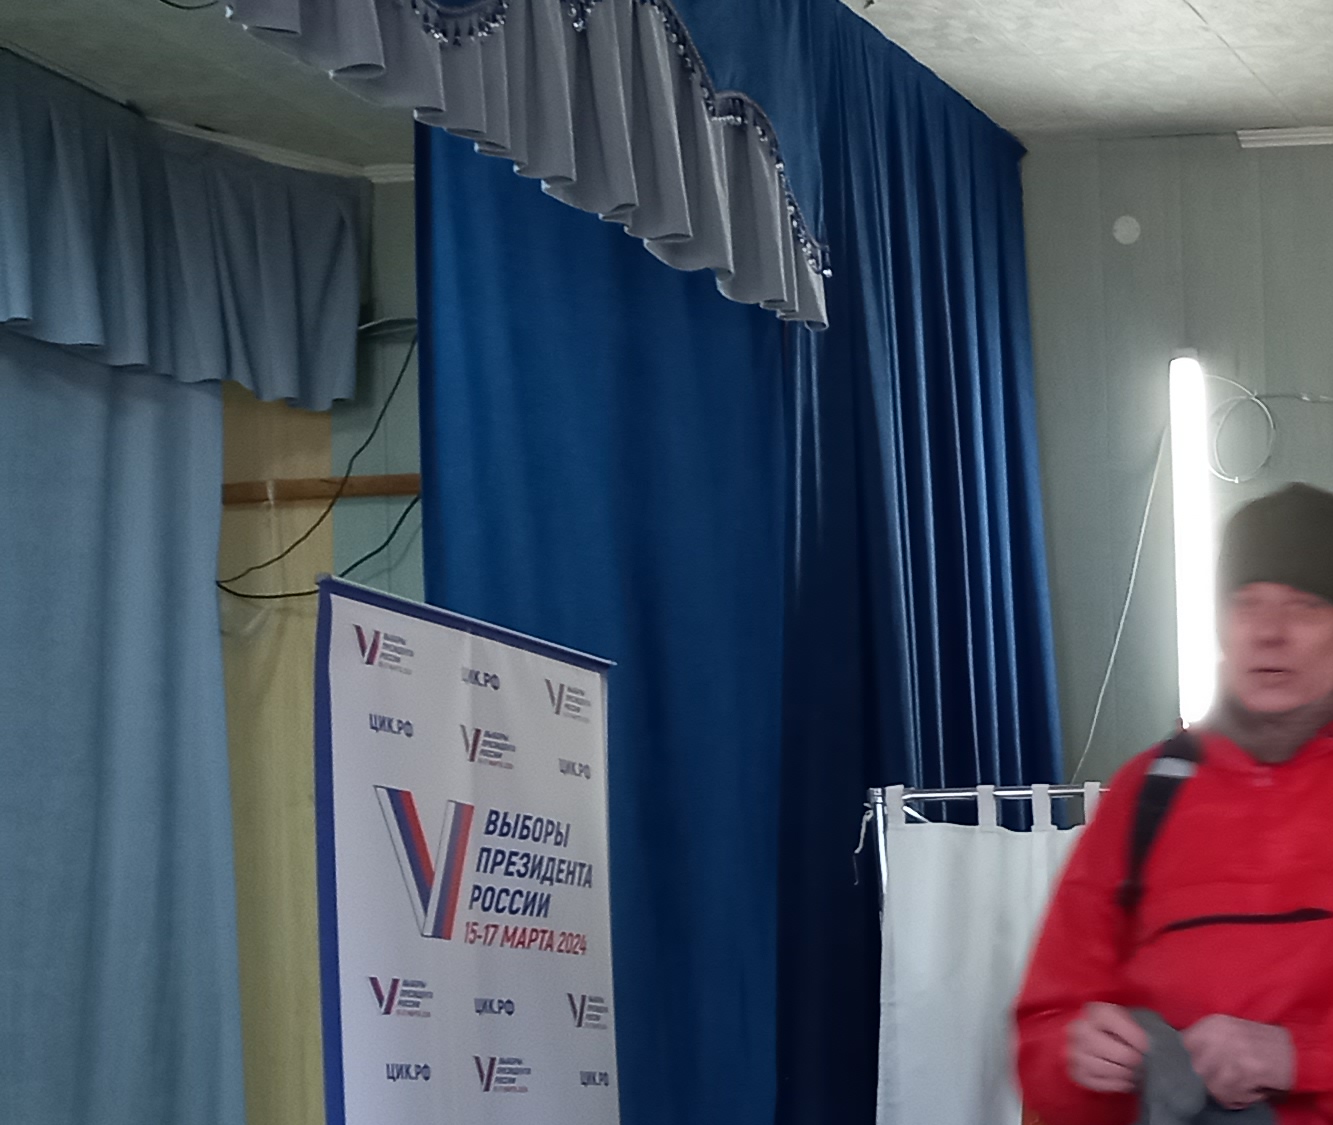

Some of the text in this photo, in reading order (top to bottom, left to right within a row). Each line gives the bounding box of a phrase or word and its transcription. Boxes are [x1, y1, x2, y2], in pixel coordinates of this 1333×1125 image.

[369, 713, 414, 738] ЦИК.РФ
[484, 809, 570, 847] ВЫБОРЫ
[476, 846, 593, 888] ПРЕЗИДЕНТА
[469, 884, 551, 918] РОССИИ
[464, 921, 588, 955] 15-17 МАРТА 2024
[474, 998, 515, 1016] ЦИК.РФ
[386, 1063, 431, 1082] ЦИК.РФ
